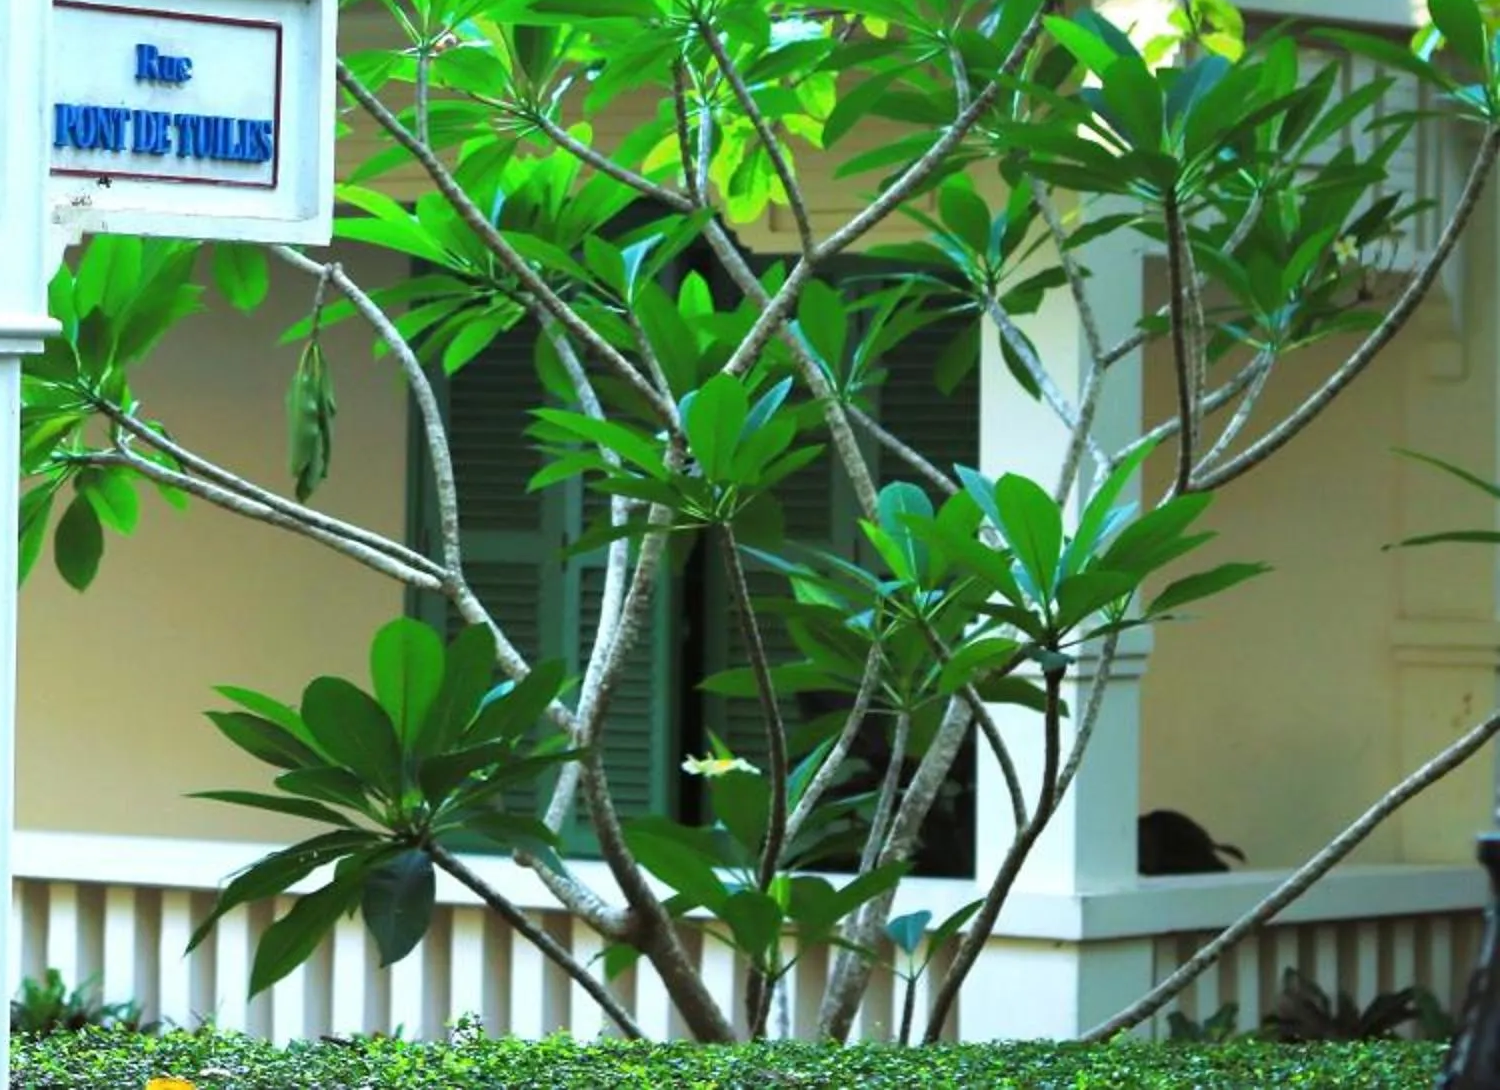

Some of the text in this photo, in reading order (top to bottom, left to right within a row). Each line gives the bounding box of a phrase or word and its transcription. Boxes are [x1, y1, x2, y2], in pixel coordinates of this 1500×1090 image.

[134, 43, 193, 83] Rue
[53, 103, 131, 151] PONT
[132, 110, 172, 154] DE
